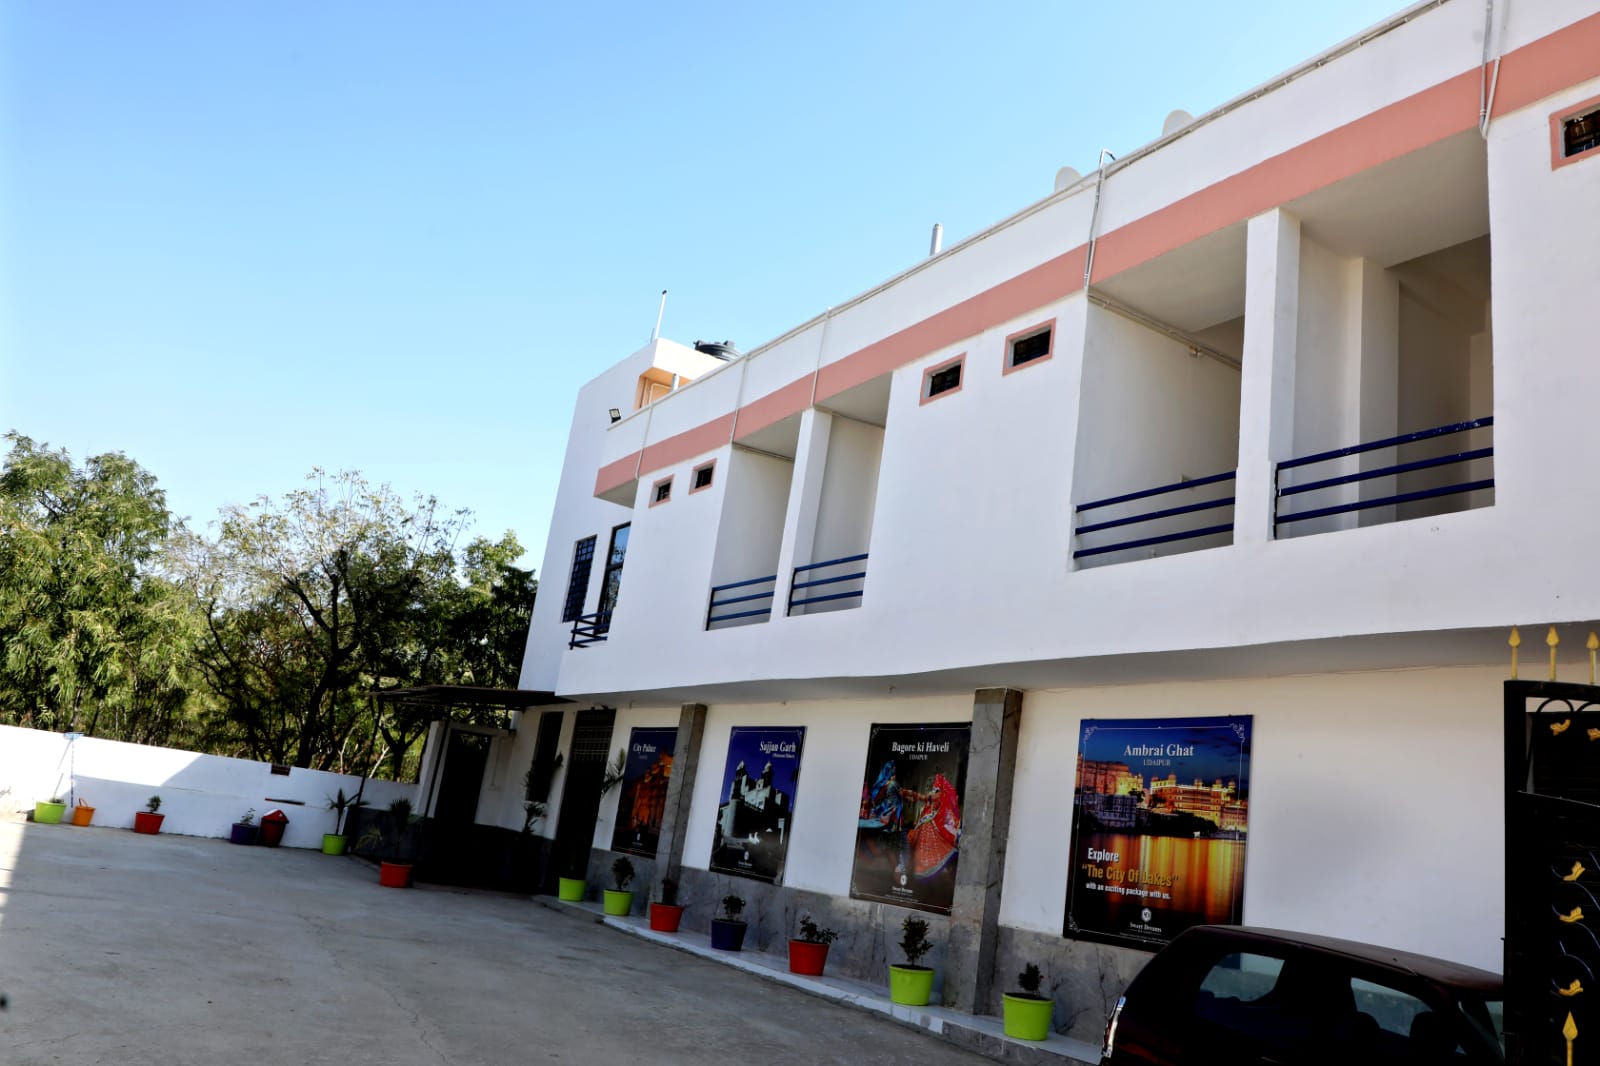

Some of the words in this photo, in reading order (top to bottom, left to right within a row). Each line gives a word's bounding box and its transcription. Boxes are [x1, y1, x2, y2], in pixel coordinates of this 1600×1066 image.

[633, 743, 642, 754] City
[760, 741, 779, 754] Sajjan
[780, 741, 796, 752] Garh
[891, 741, 916, 755] Bagore
[917, 741, 925, 752] ki
[926, 741, 950, 752] Haveli
[1123, 744, 1164, 756] Ambrai
[1166, 744, 1194, 757] Ghat
[1087, 847, 1120, 863] Explore
[1106, 866, 1126, 883] City
[1127, 868, 1140, 883] Of
[1085, 882, 1097, 890] with
[1097, 883, 1105, 891] an
[1104, 884, 1126, 896] exciting
[1126, 887, 1149, 898] package
[1149, 889, 1161, 898] with
[1162, 892, 1171, 900] us.
